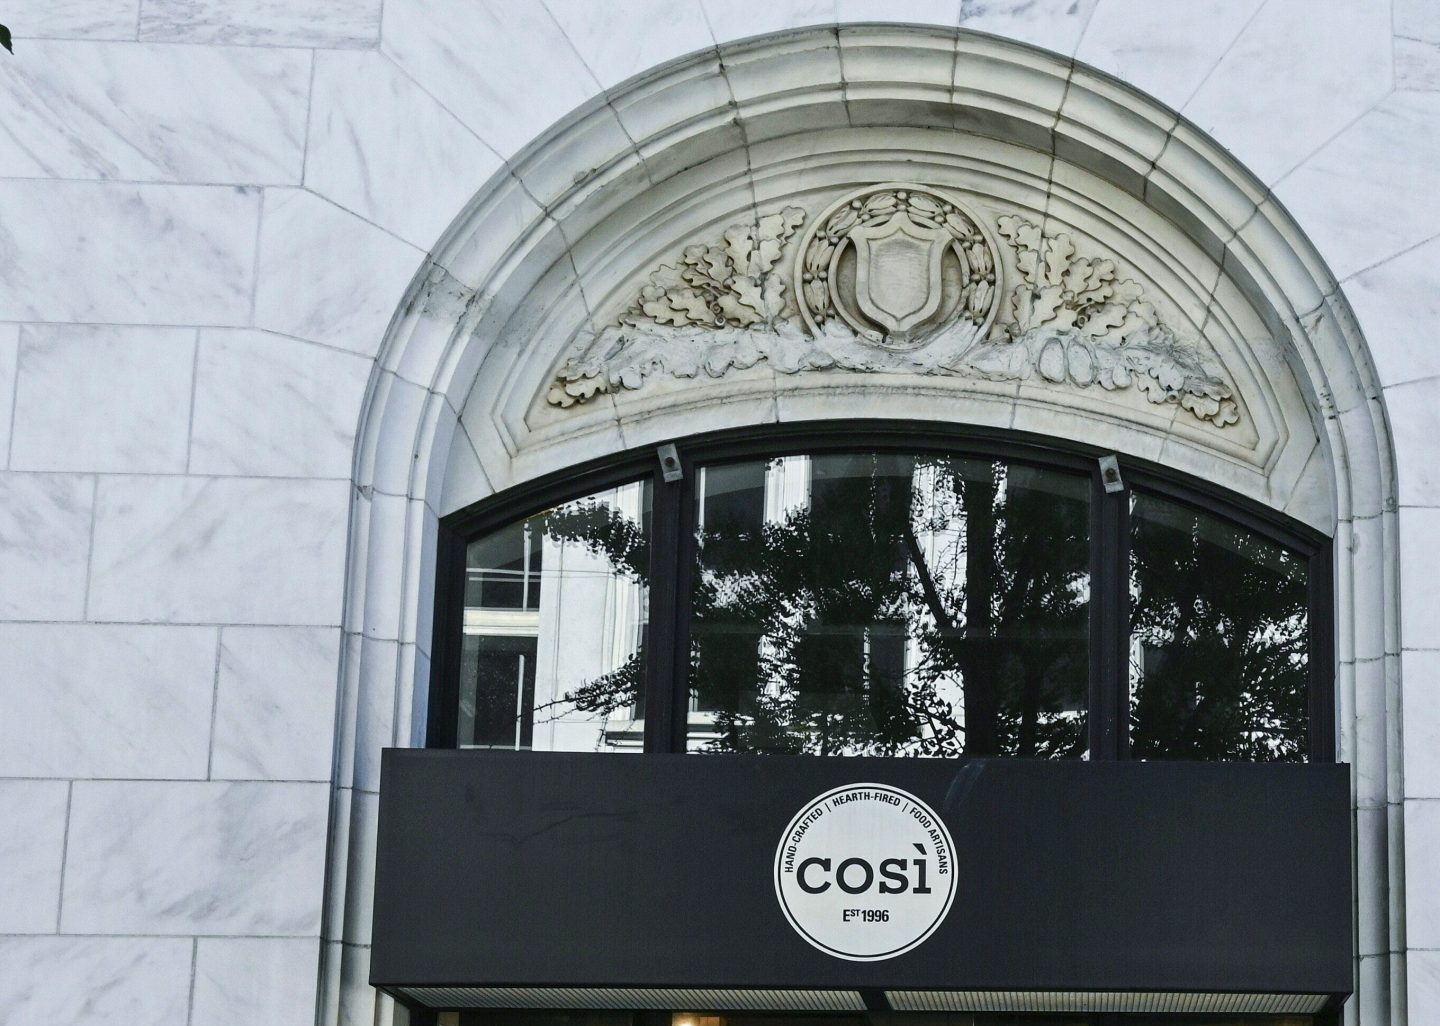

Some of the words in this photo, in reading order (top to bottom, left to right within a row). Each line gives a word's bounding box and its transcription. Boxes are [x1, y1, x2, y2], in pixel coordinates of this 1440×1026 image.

[784, 807, 824, 873] HAND-CRAFTED
[832, 791, 901, 807] HEARTH-FIRED
[909, 807, 931, 829] FOOD
[928, 828, 948, 875] ARTISANS
[861, 909, 889, 923] 1996
